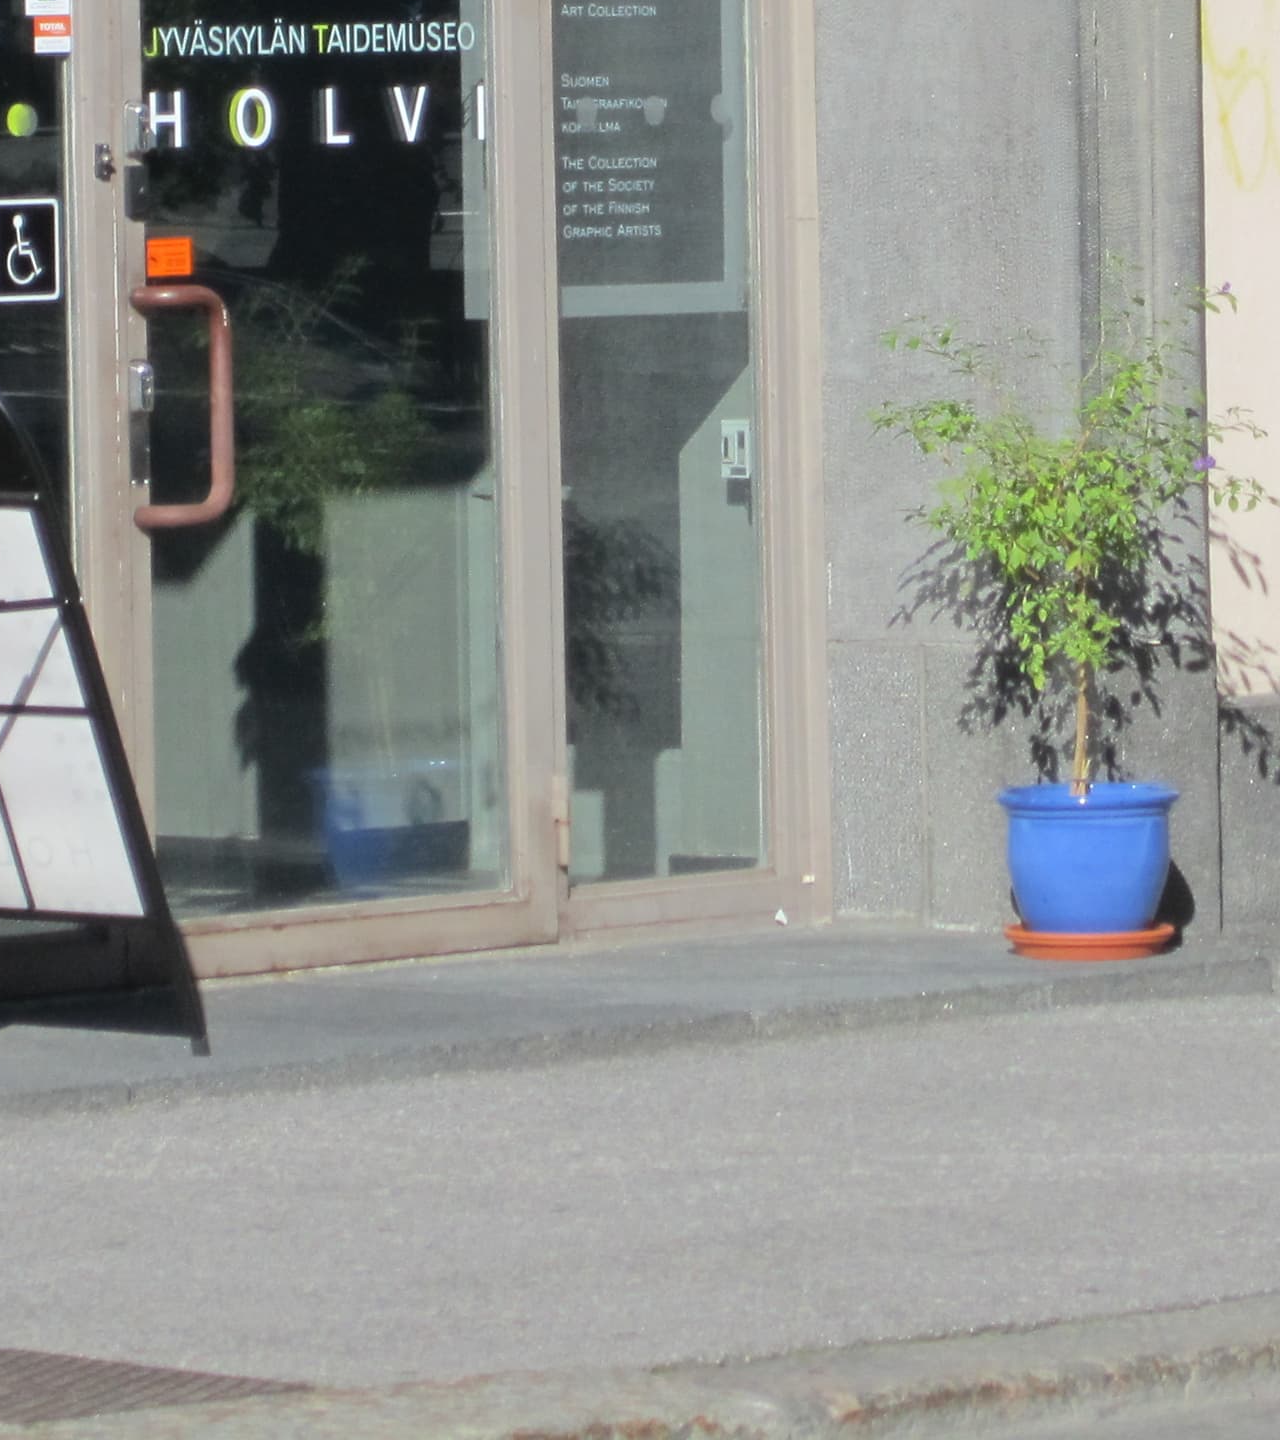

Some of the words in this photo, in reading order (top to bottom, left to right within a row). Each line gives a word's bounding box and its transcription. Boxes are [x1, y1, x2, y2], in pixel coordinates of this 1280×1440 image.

[560, 3, 584, 17] ART
[587, 3, 658, 17] COLLECTION
[143, 18, 307, 58] JYVÄSKYLÄN
[312, 21, 476, 55] TAIDEMUSEO
[560, 73, 610, 88] SUOMEN
[148, 84, 486, 148] HOLVI
[561, 156, 585, 170] THE
[587, 155, 658, 169] COLLECTION
[562, 181, 579, 193] OF
[583, 181, 604, 192] THE
[607, 177, 656, 192] SOCIETY
[562, 204, 579, 216] OF
[583, 204, 605, 215] THE
[608, 201, 651, 215] FINNISH
[563, 224, 614, 239] GRAPHIC
[616, 224, 662, 238] ARTISTS
